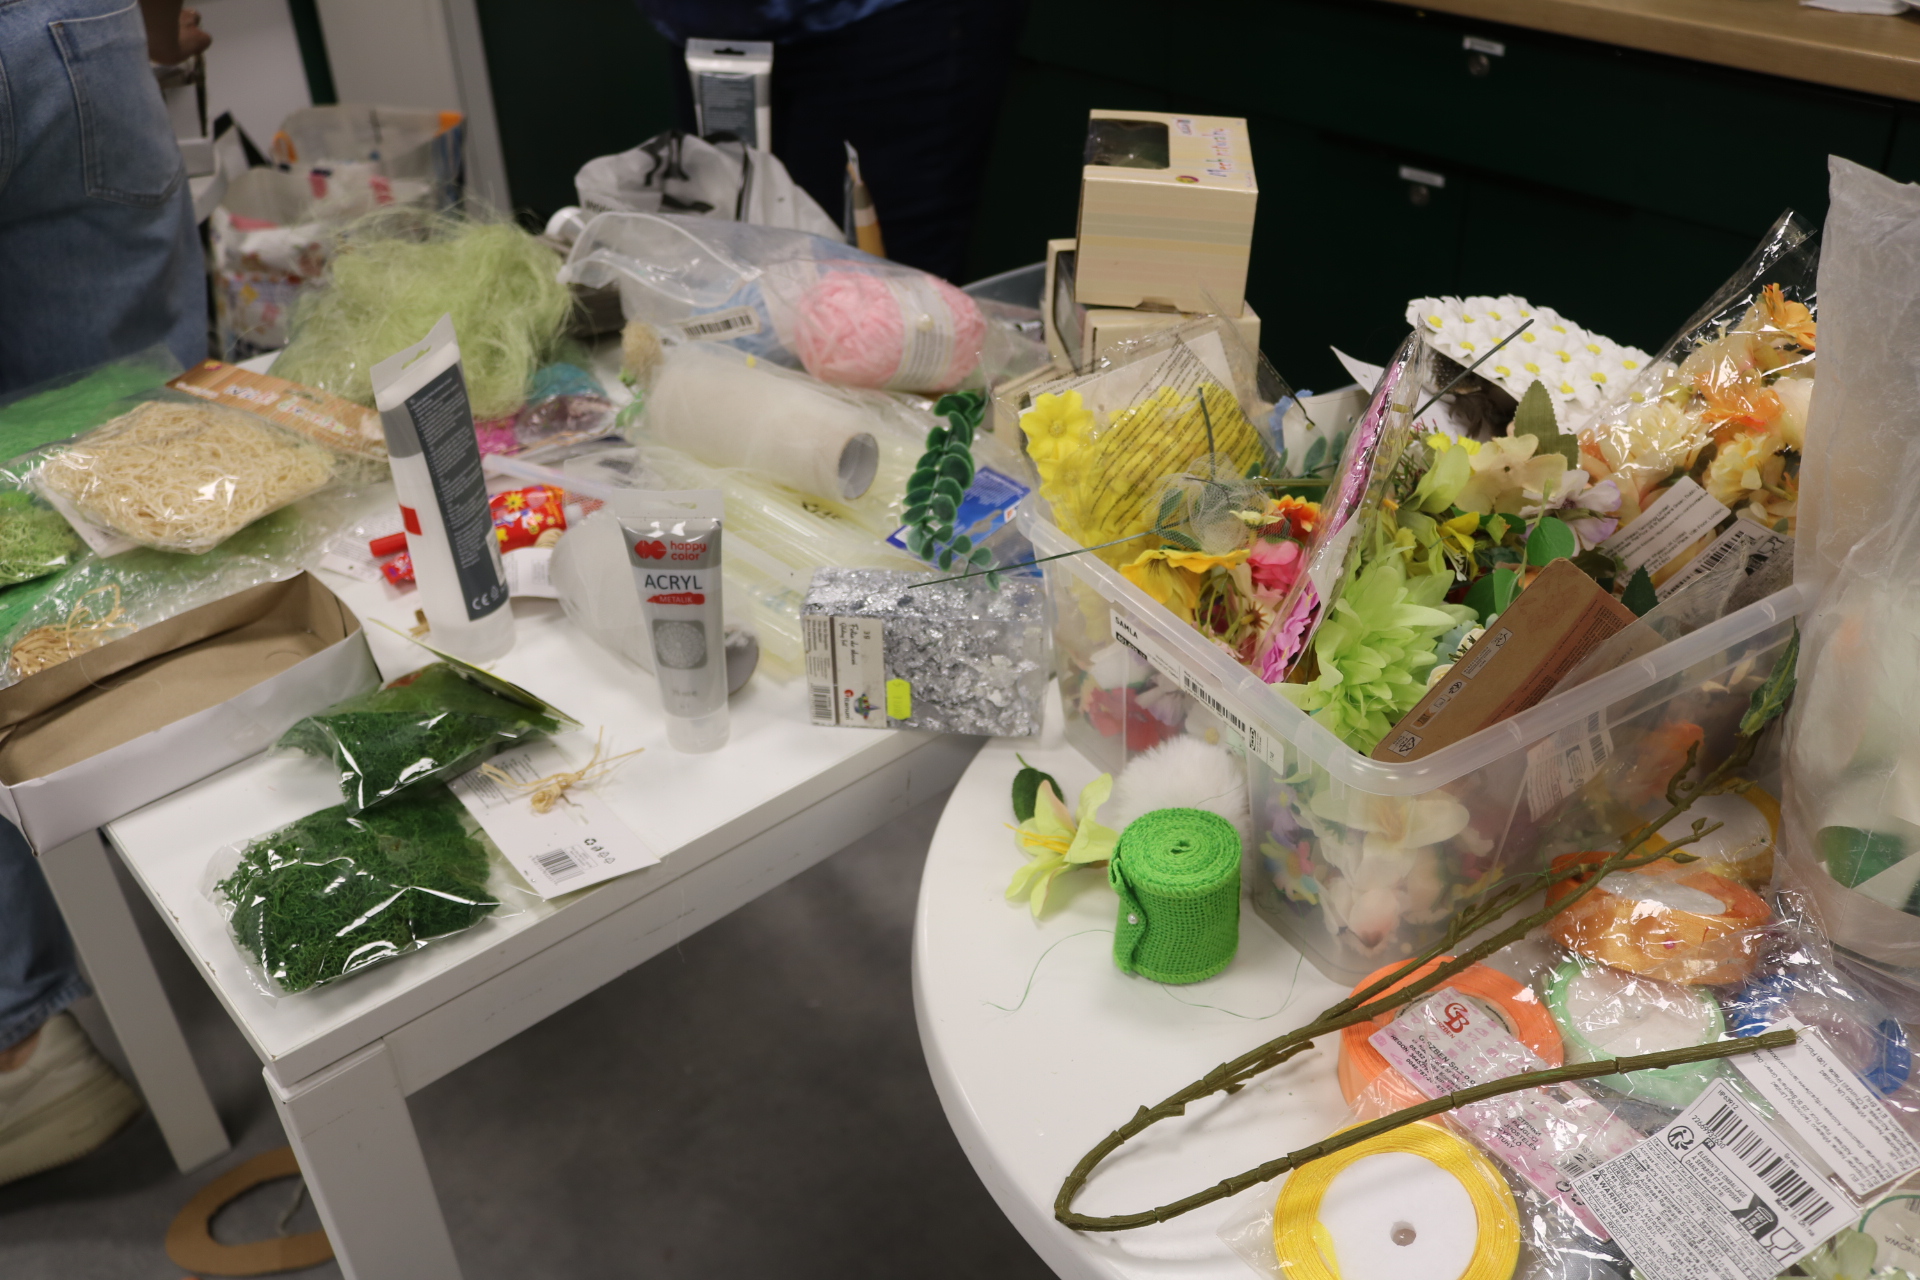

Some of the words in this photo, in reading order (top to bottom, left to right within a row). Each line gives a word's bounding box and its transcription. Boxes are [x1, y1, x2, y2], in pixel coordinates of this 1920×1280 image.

[670, 541, 707, 553] happy
[671, 552, 700, 561] color
[644, 574, 703, 590] ACRYL
[1114, 616, 1138, 639] SAMLA
[1750, 1050, 1764, 1063] Dubl
[1703, 1138, 1714, 1148] FR
[1600, 1181, 1628, 1214] WARNING
